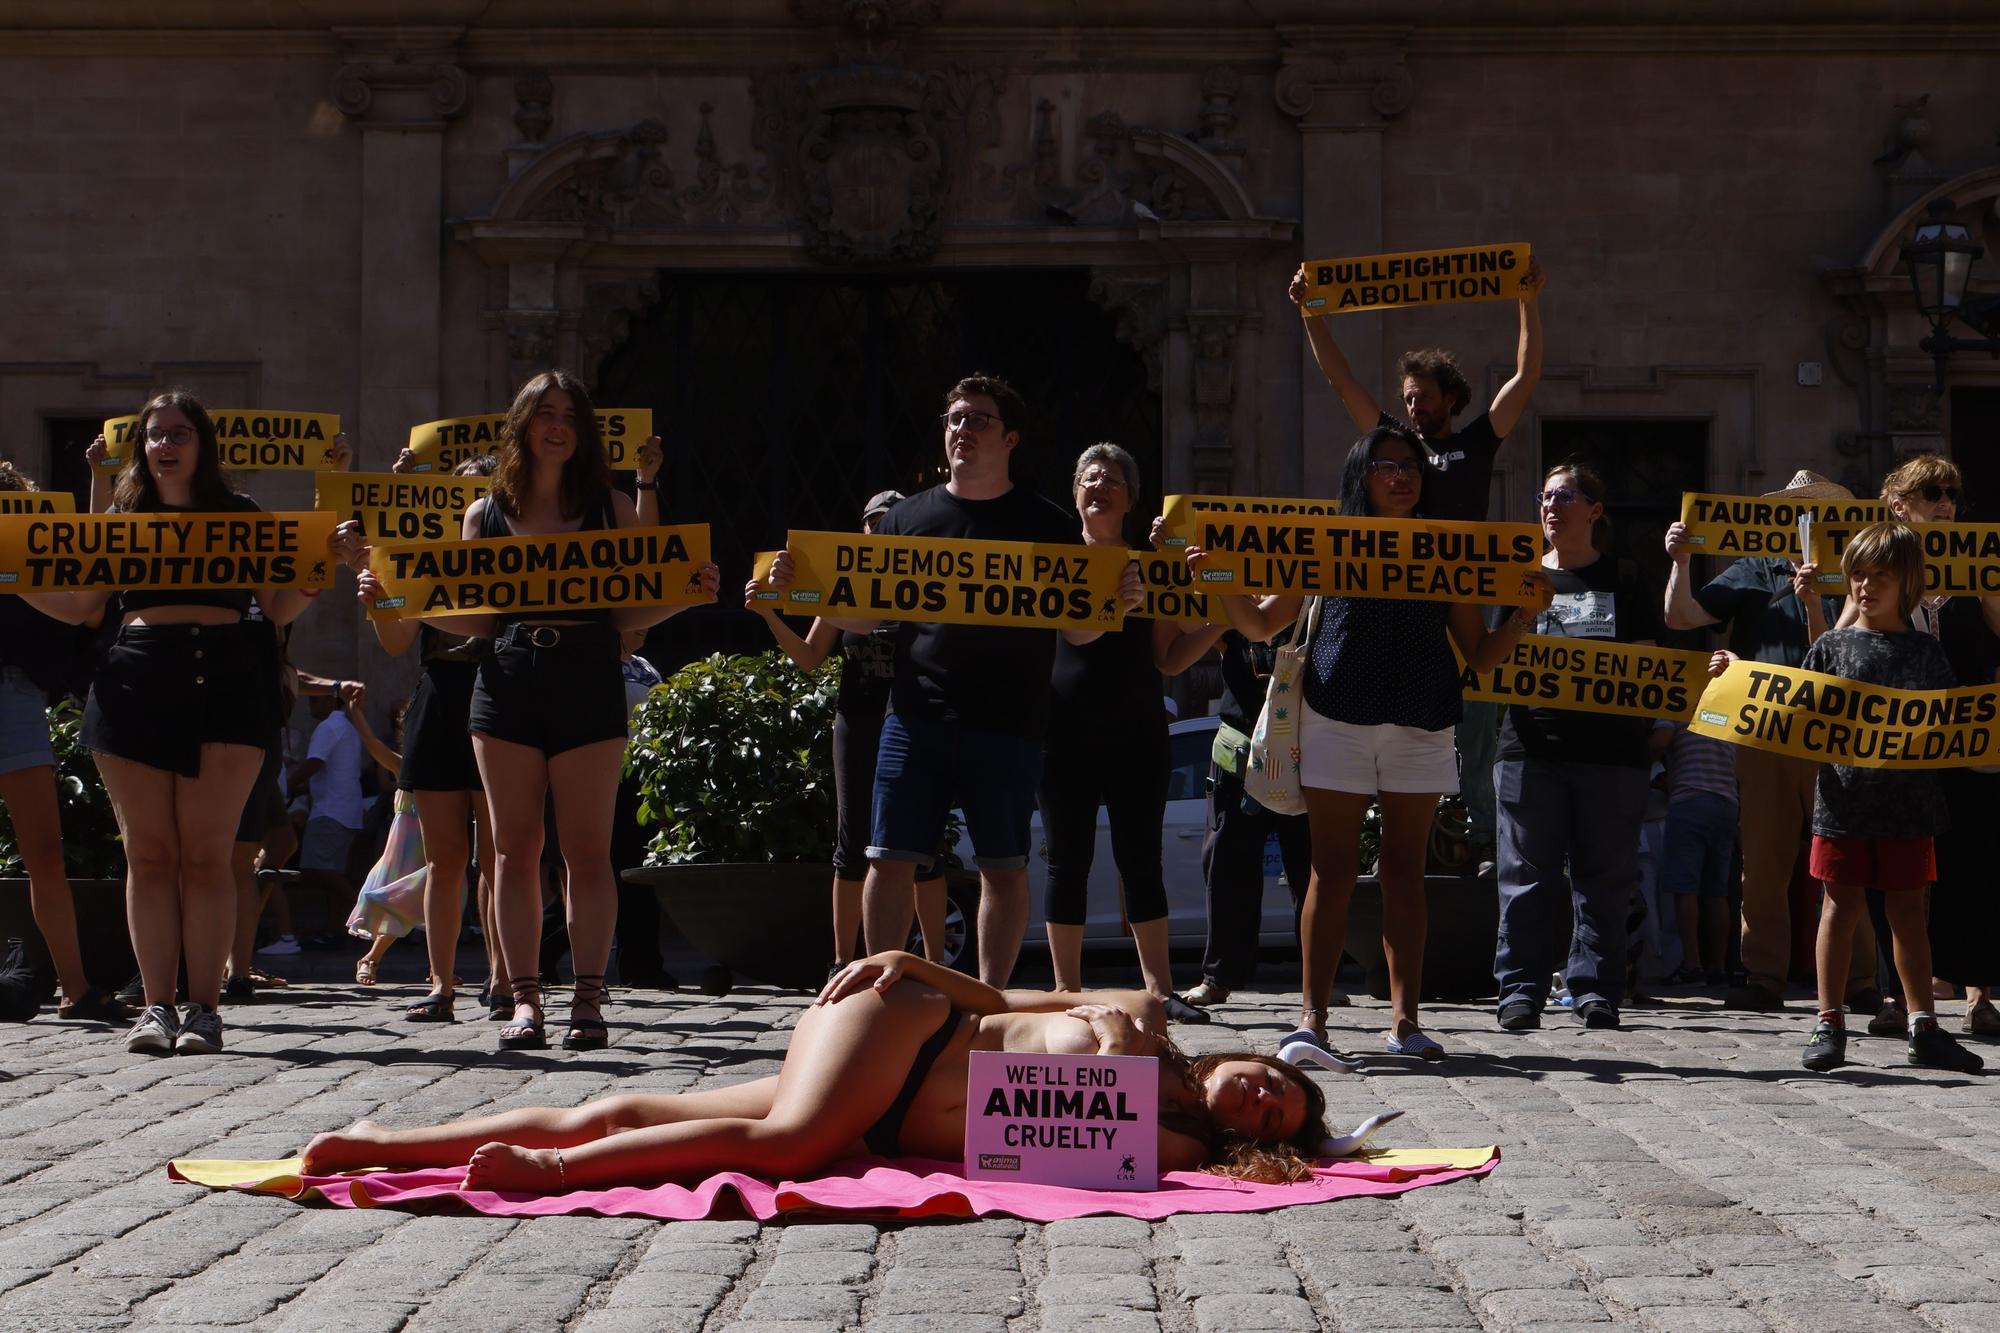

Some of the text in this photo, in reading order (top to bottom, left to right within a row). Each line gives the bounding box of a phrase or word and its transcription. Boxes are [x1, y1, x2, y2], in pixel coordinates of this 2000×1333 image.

[1317, 250, 1516, 285] BULLFIGHTING
[1339, 276, 1500, 308] ABOLITION
[351, 482, 466, 510] DEJEMOS
[27, 520, 299, 554] CRUELTY FREE
[378, 511, 444, 539] LOS
[390, 534, 690, 579] TAUROMAQUIA
[1205, 524, 1535, 563] MAKE THE BULLS
[26, 556, 297, 587] TRADITIONS
[836, 545, 1089, 585] DEJEMOS EN PAZ
[1244, 558, 1497, 597] LIVE IN PEACE
[423, 565, 663, 612] ABOLICIÓN
[828, 576, 1093, 620] A LOS TOROS
[1595, 651, 1629, 677] EN
[1637, 656, 1687, 683] PAZ
[1493, 668, 1560, 700] LOS
[1571, 675, 1687, 713] TOROS
[1748, 670, 1997, 726] TRADICIONES
[1734, 704, 1990, 761] SIN CRUELDAD
[1006, 1065, 1118, 1087] WE'LL END
[983, 1088, 1138, 1121] ANIMAL
[1004, 1124, 1118, 1150] CRUELTY
